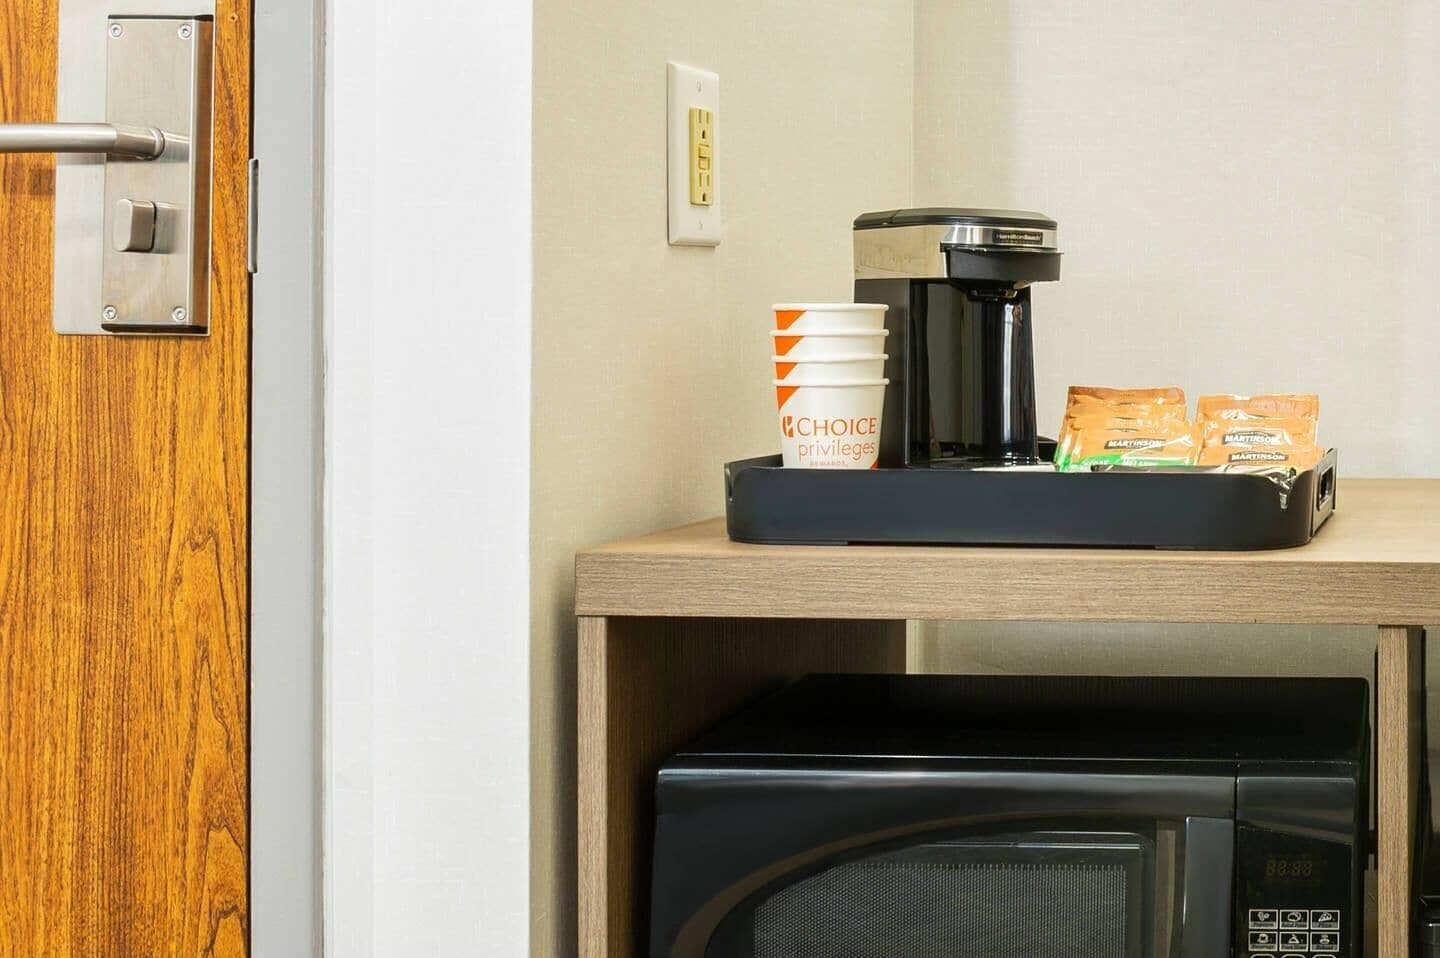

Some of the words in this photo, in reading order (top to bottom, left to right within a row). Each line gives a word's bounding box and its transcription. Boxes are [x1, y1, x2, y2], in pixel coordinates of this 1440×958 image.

[796, 417, 878, 437] CHOICE
[1225, 434, 1281, 443] MARTINSON
[798, 439, 876, 462] privileges
[1231, 453, 1286, 461] MARTINSON
